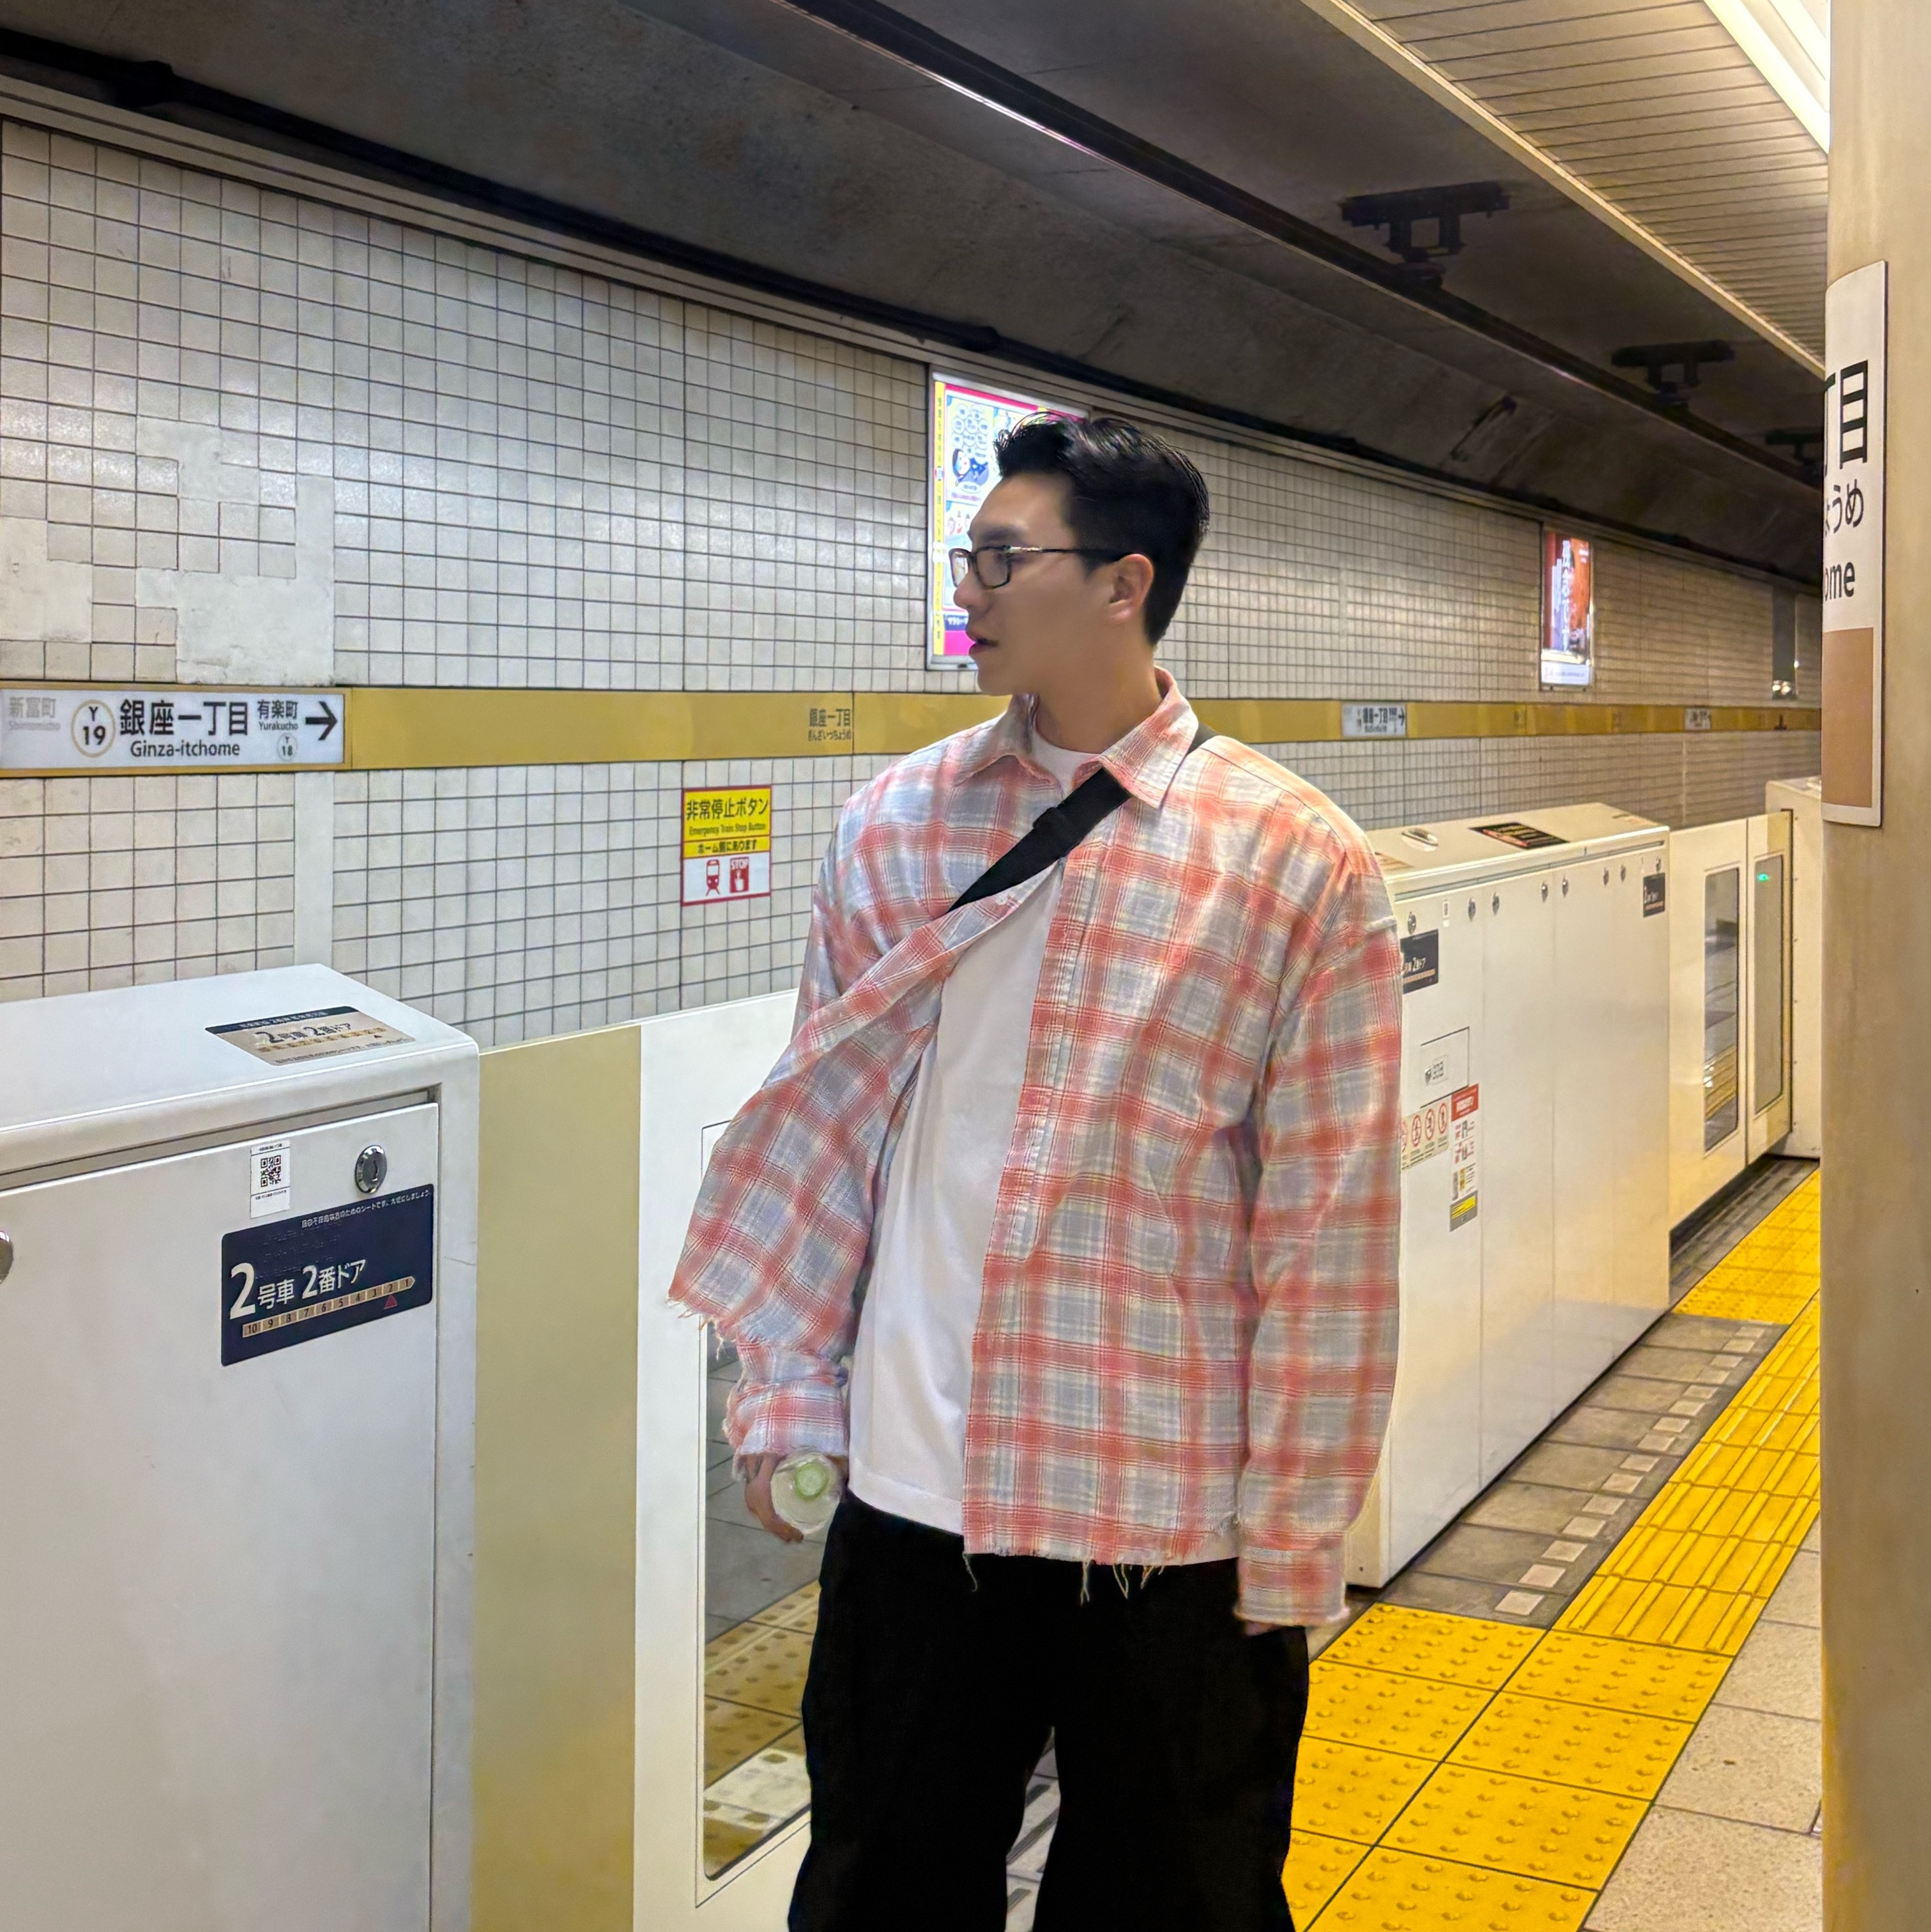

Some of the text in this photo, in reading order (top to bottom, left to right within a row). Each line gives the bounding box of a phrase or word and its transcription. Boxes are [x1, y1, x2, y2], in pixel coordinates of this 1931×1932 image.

[89, 706, 98, 722] Y
[119, 699, 248, 736] 銀座一丁目
[257, 699, 298, 720] 有楽町
[83, 725, 106, 745] 19
[258, 721, 299, 731] Yurakucho
[130, 739, 240, 757] Ginza-itchome
[282, 745, 293, 757] 18
[686, 797, 768, 821] 非常停止ボタン
[689, 825, 719, 837] Emergency
[721, 823, 734, 833] Train
[735, 822, 747, 833] Stop
[731, 858, 749, 870] STOP
[229, 1259, 366, 1320] 2号車 2番ドア
[248, 1323, 257, 1334] 10
[268, 1318, 273, 1328] 9
[286, 1314, 291, 1323] 8
[304, 1308, 309, 1318] 7
[321, 1303, 326, 1312] 6
[339, 1298, 344, 1307] 5
[355, 1293, 360, 1302] 4
[372, 1289, 377, 1297] 3
[388, 1284, 393, 1292] 2
